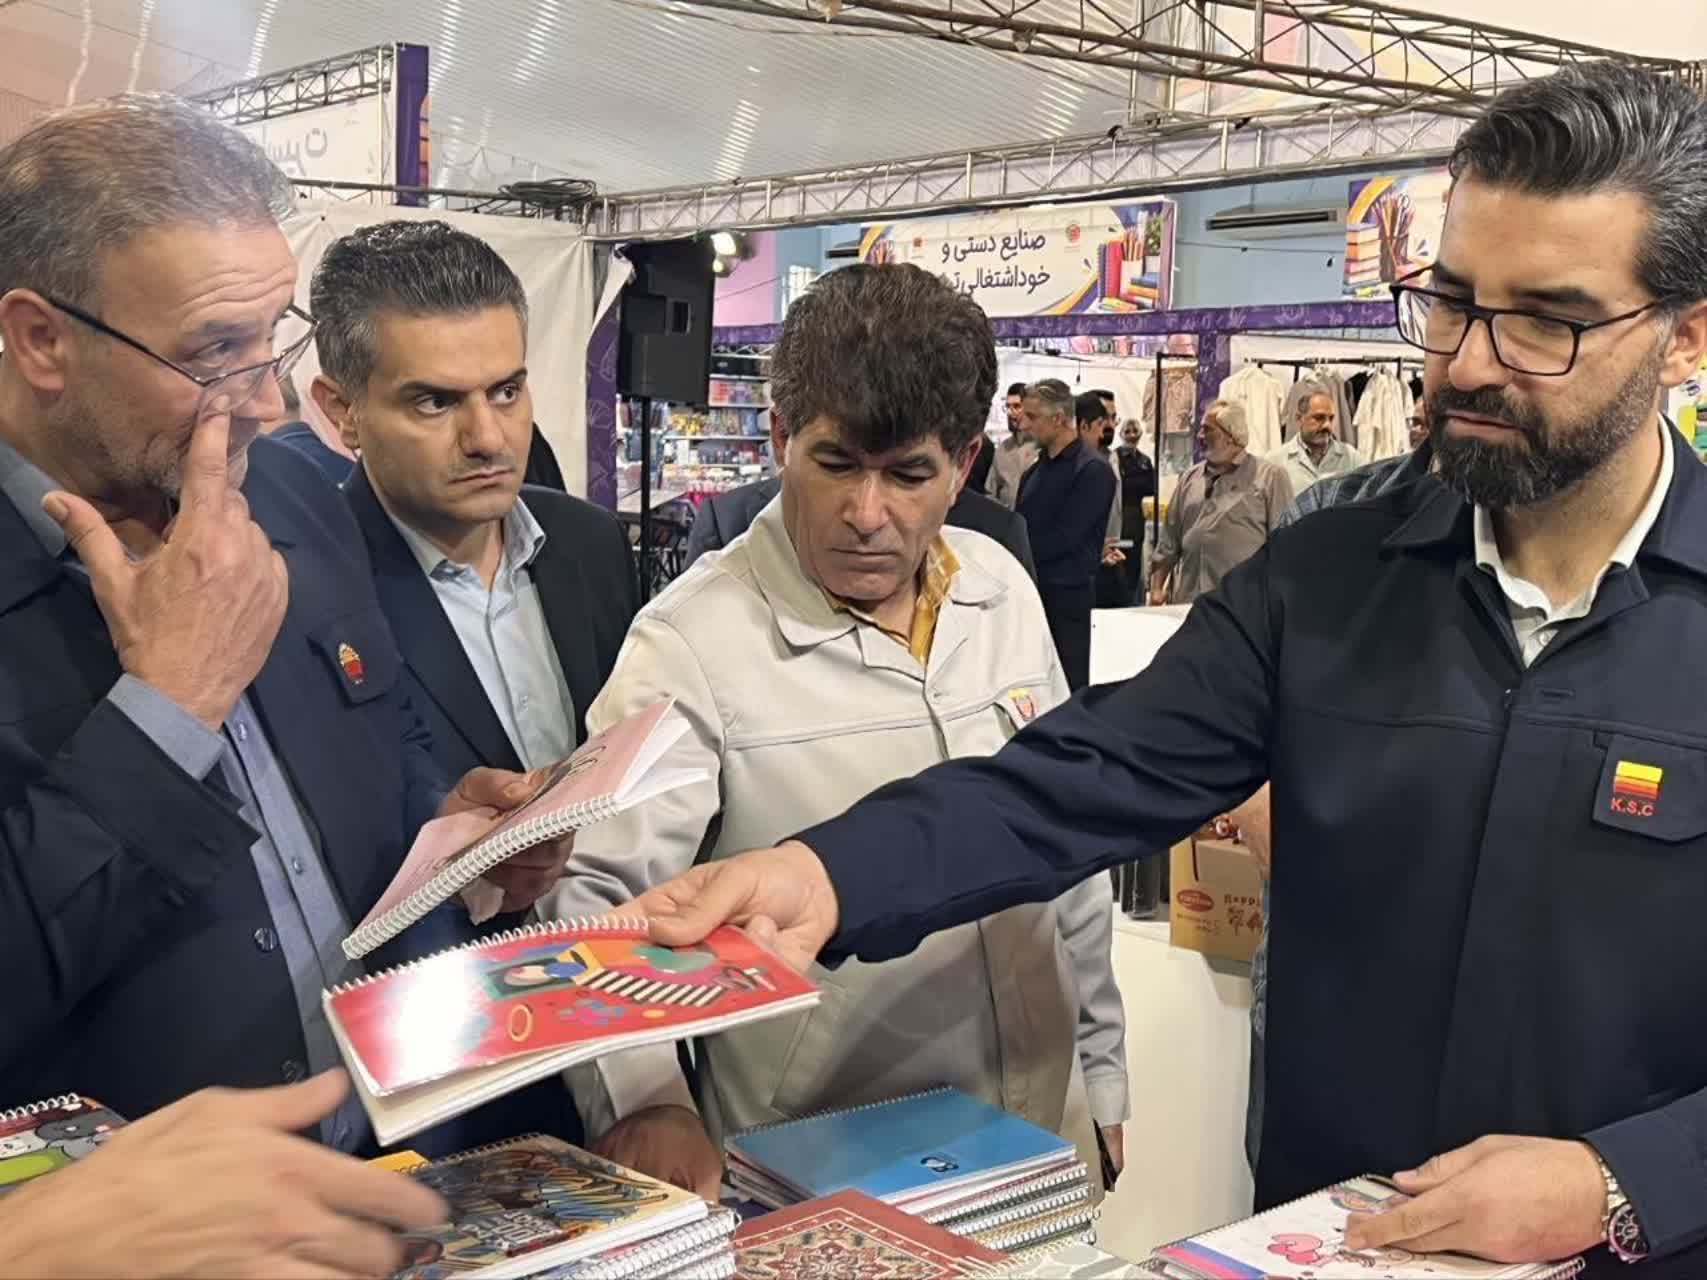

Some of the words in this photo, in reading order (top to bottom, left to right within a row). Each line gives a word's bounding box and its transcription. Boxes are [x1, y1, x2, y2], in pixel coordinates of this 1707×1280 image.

[941, 242, 950, 264] و
[953, 235, 996, 262] دستی
[1000, 228, 1046, 261] صنایع
[961, 265, 1051, 297] خوداشتغالی
